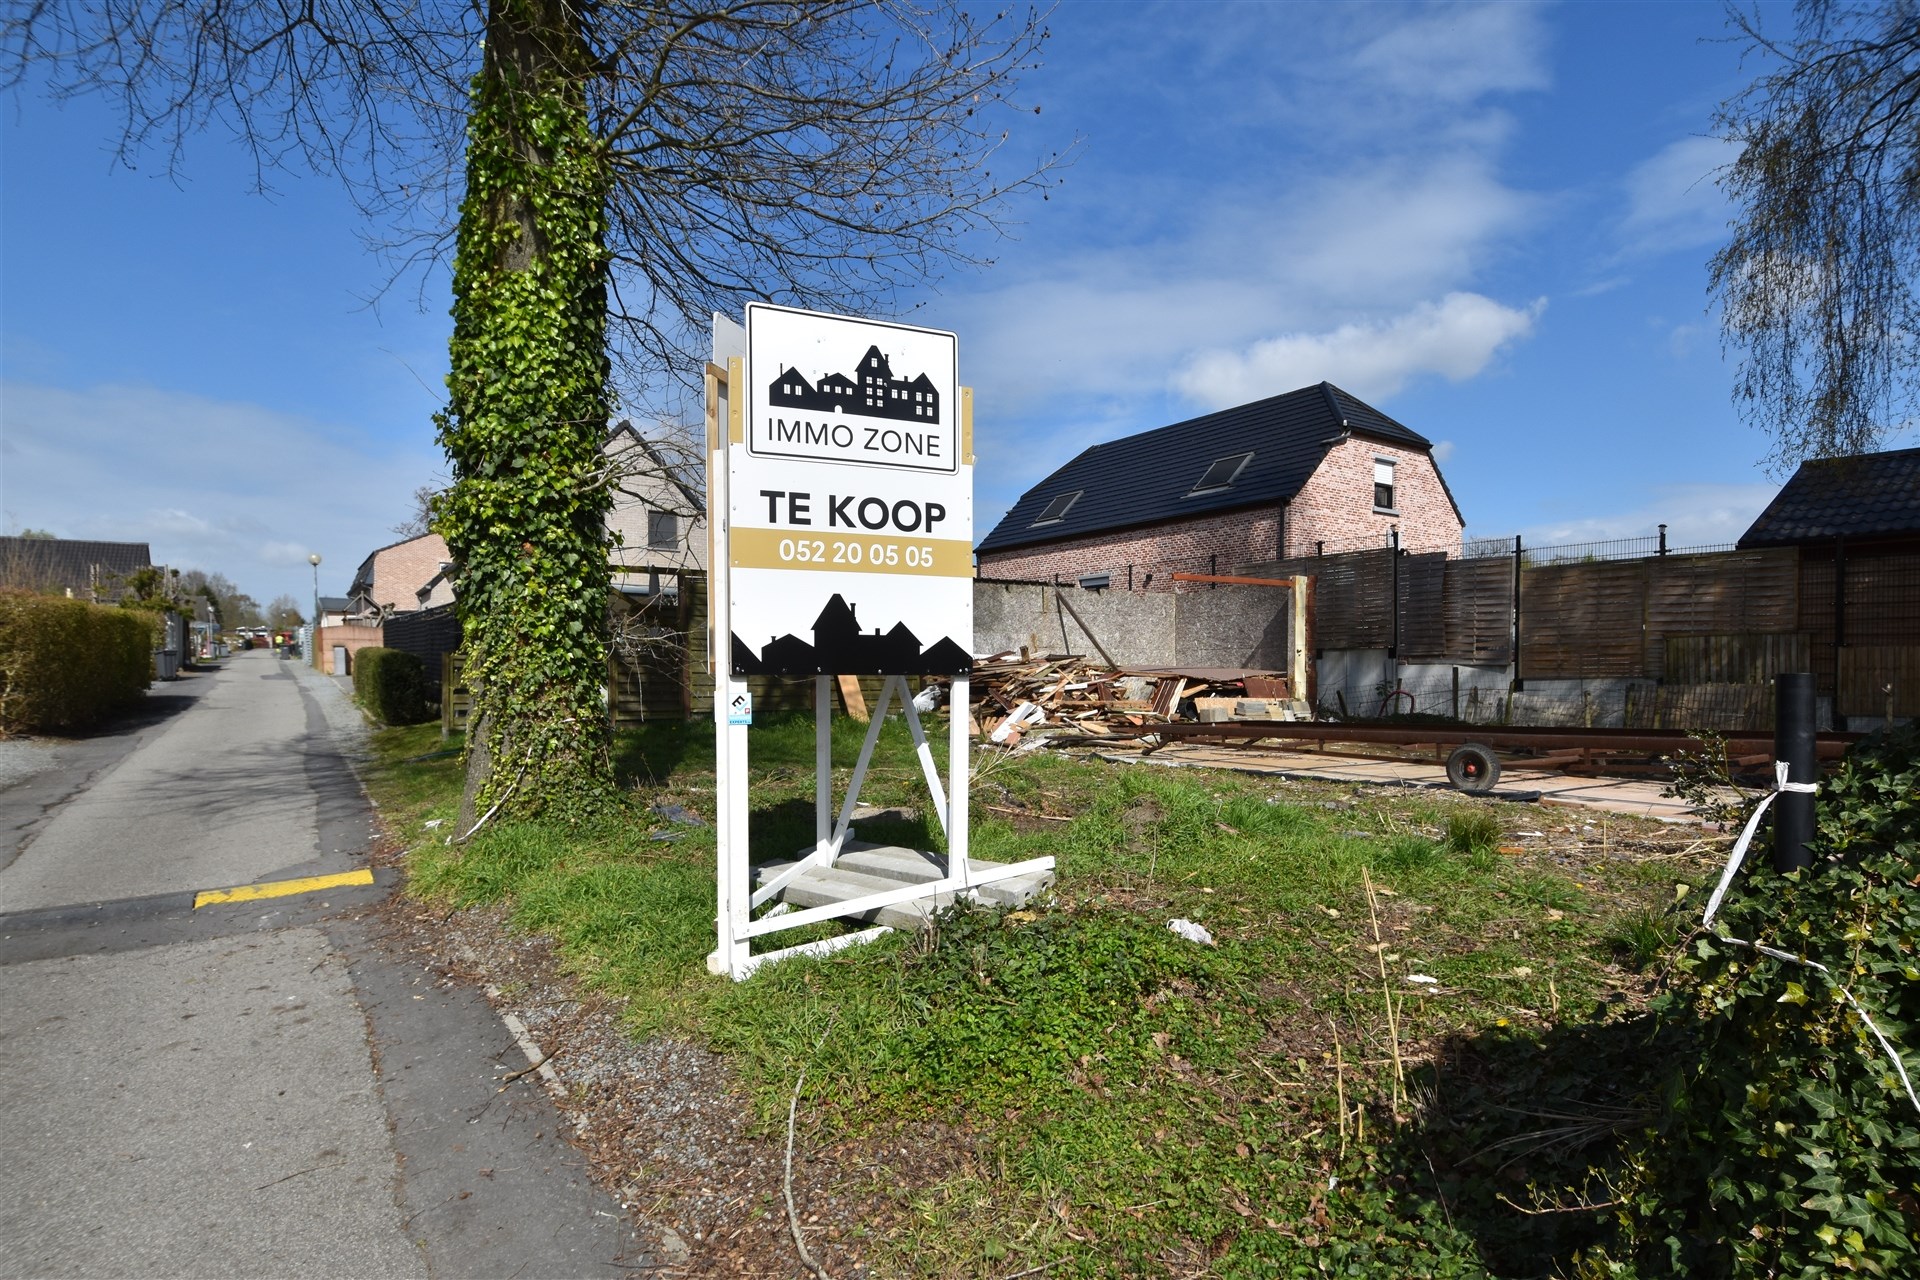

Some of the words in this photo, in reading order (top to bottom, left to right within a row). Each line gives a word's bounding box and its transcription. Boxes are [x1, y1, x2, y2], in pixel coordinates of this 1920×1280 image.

[768, 417, 854, 448] IMMO
[863, 427, 941, 457] ZONE
[759, 489, 812, 526] TE
[828, 494, 946, 533] KOOP
[779, 538, 826, 563] 052
[832, 541, 863, 564] 20
[869, 543, 899, 566] 05
[905, 545, 934, 567] 05
